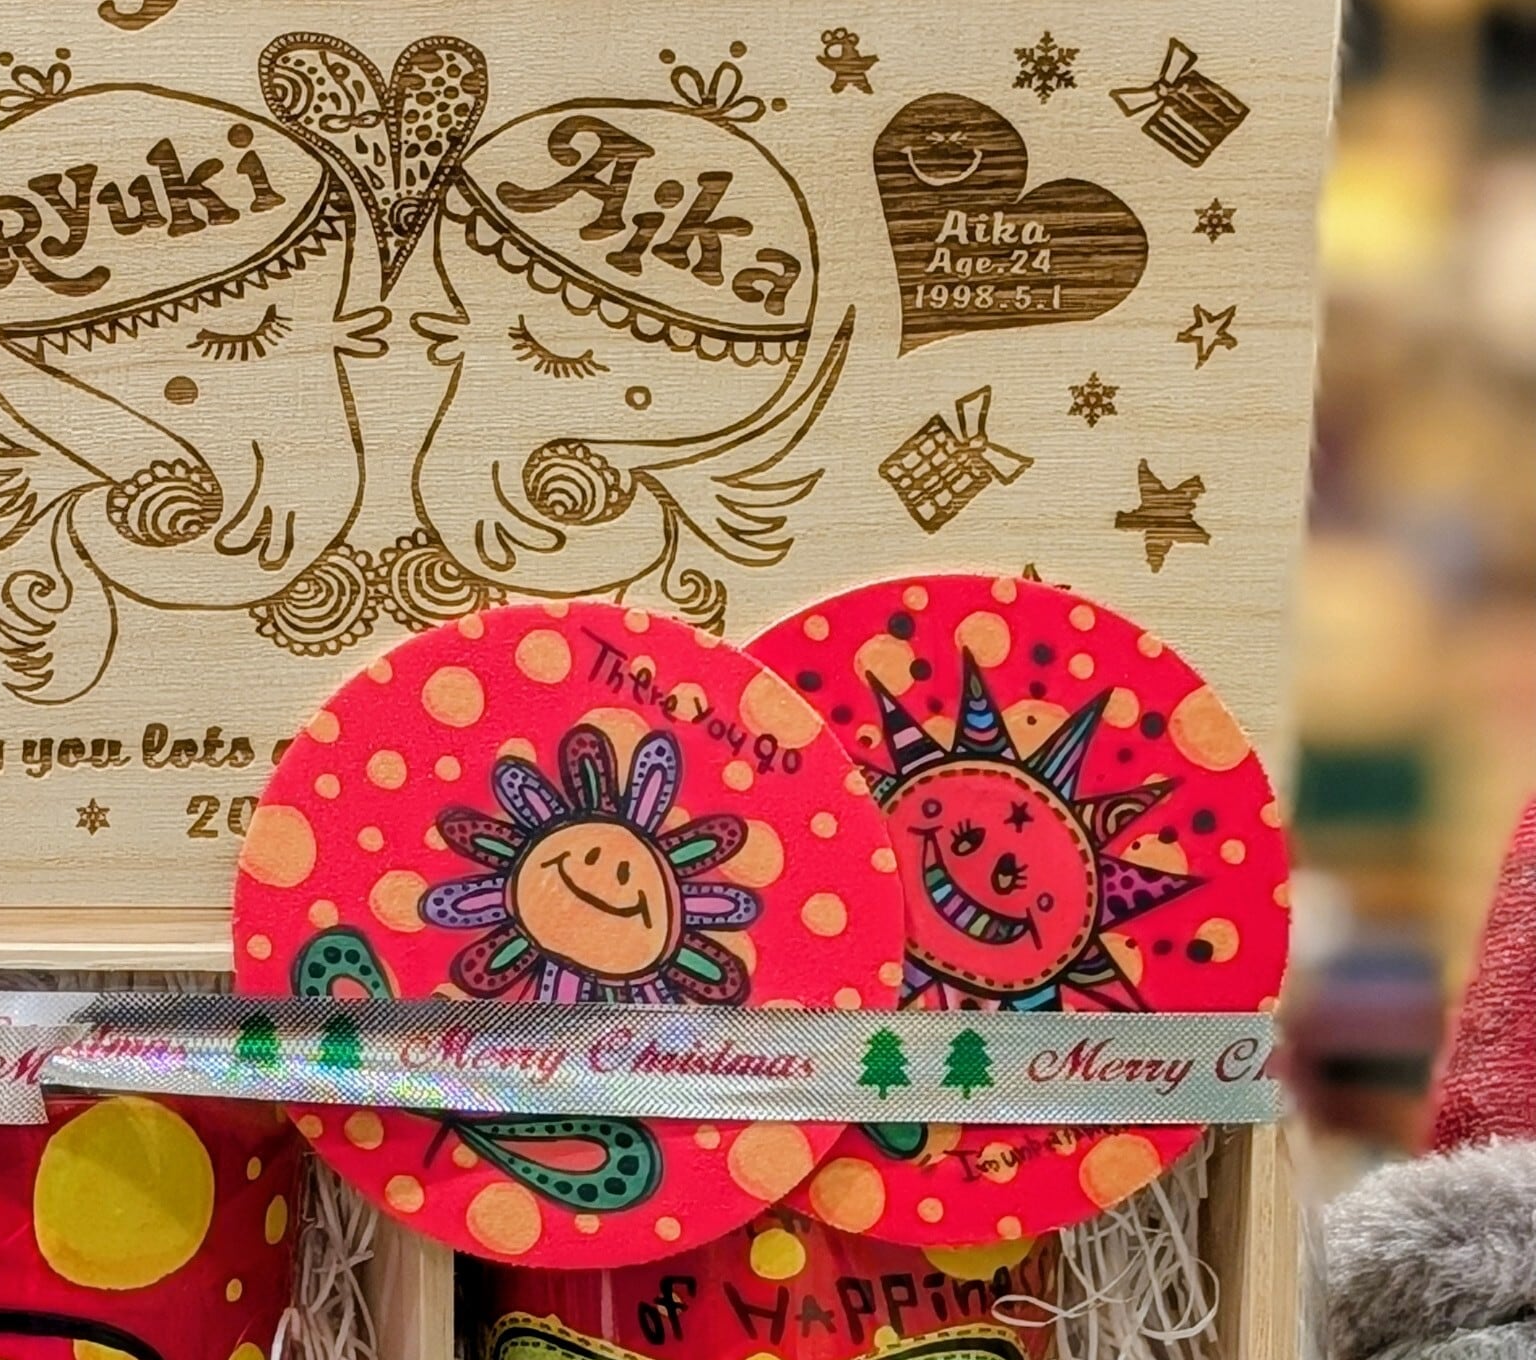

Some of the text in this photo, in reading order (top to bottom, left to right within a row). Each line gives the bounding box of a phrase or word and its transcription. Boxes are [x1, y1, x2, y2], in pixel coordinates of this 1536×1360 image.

[497, 115, 799, 314] Aika
[935, 210, 1051, 245] Aika
[915, 284, 1061, 311] 1998.5.1
[21, 735, 132, 778] you
[141, 722, 257, 769] lots
[399, 1024, 815, 1086] Merry Christmas
[1027, 1037, 1196, 1096] Merry
